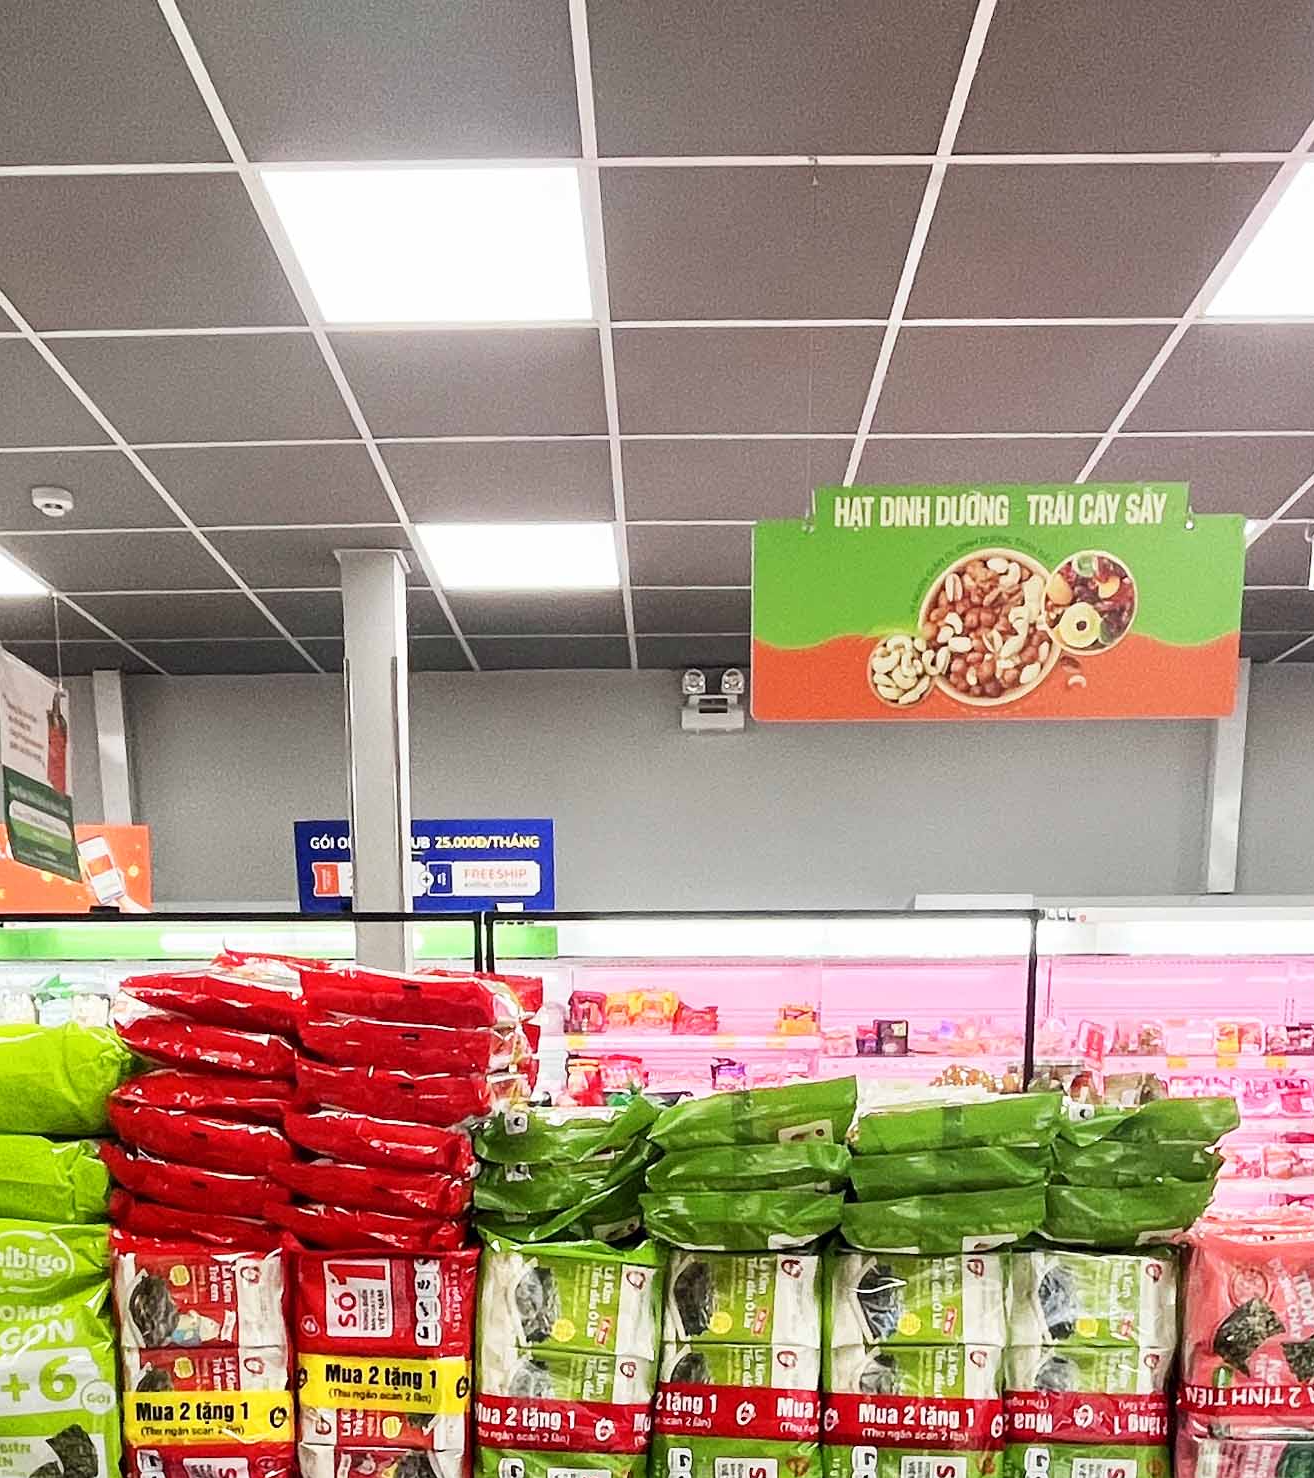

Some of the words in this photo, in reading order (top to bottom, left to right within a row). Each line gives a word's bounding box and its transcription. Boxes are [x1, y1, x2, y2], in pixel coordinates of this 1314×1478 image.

[834, 496, 875, 531] HẠT
[879, 496, 930, 527] DINH
[310, 833, 335, 850] GÓI
[464, 868, 528, 879] FREESHIP
[326, 1262, 386, 1286] 1
[331, 1292, 358, 1328] SỐ
[326, 1364, 363, 1384] Mua
[369, 1367, 379, 1385] 2
[384, 1367, 424, 1390] tặng
[429, 1370, 437, 1388] 1
[665, 1393, 704, 1417] tặng
[710, 1394, 717, 1413] 1
[777, 1397, 813, 1419] Mua
[1232, 1387, 1284, 1409] TÍNH
[1290, 1386, 1301, 1407] 2
[136, 1403, 173, 1421] Mua
[180, 1402, 190, 1420] 2
[195, 1401, 235, 1425] tặng
[241, 1402, 248, 1420] 1
[506, 1407, 517, 1426] 2
[521, 1406, 562, 1432] tặng
[568, 1410, 575, 1429] 1
[859, 1404, 899, 1425] Mua
[904, 1405, 916, 1425] 2
[920, 1405, 960, 1430] tặng
[966, 1407, 974, 1427] 1
[1014, 1412, 1053, 1433] Mua
[1113, 1413, 1121, 1434] 1
